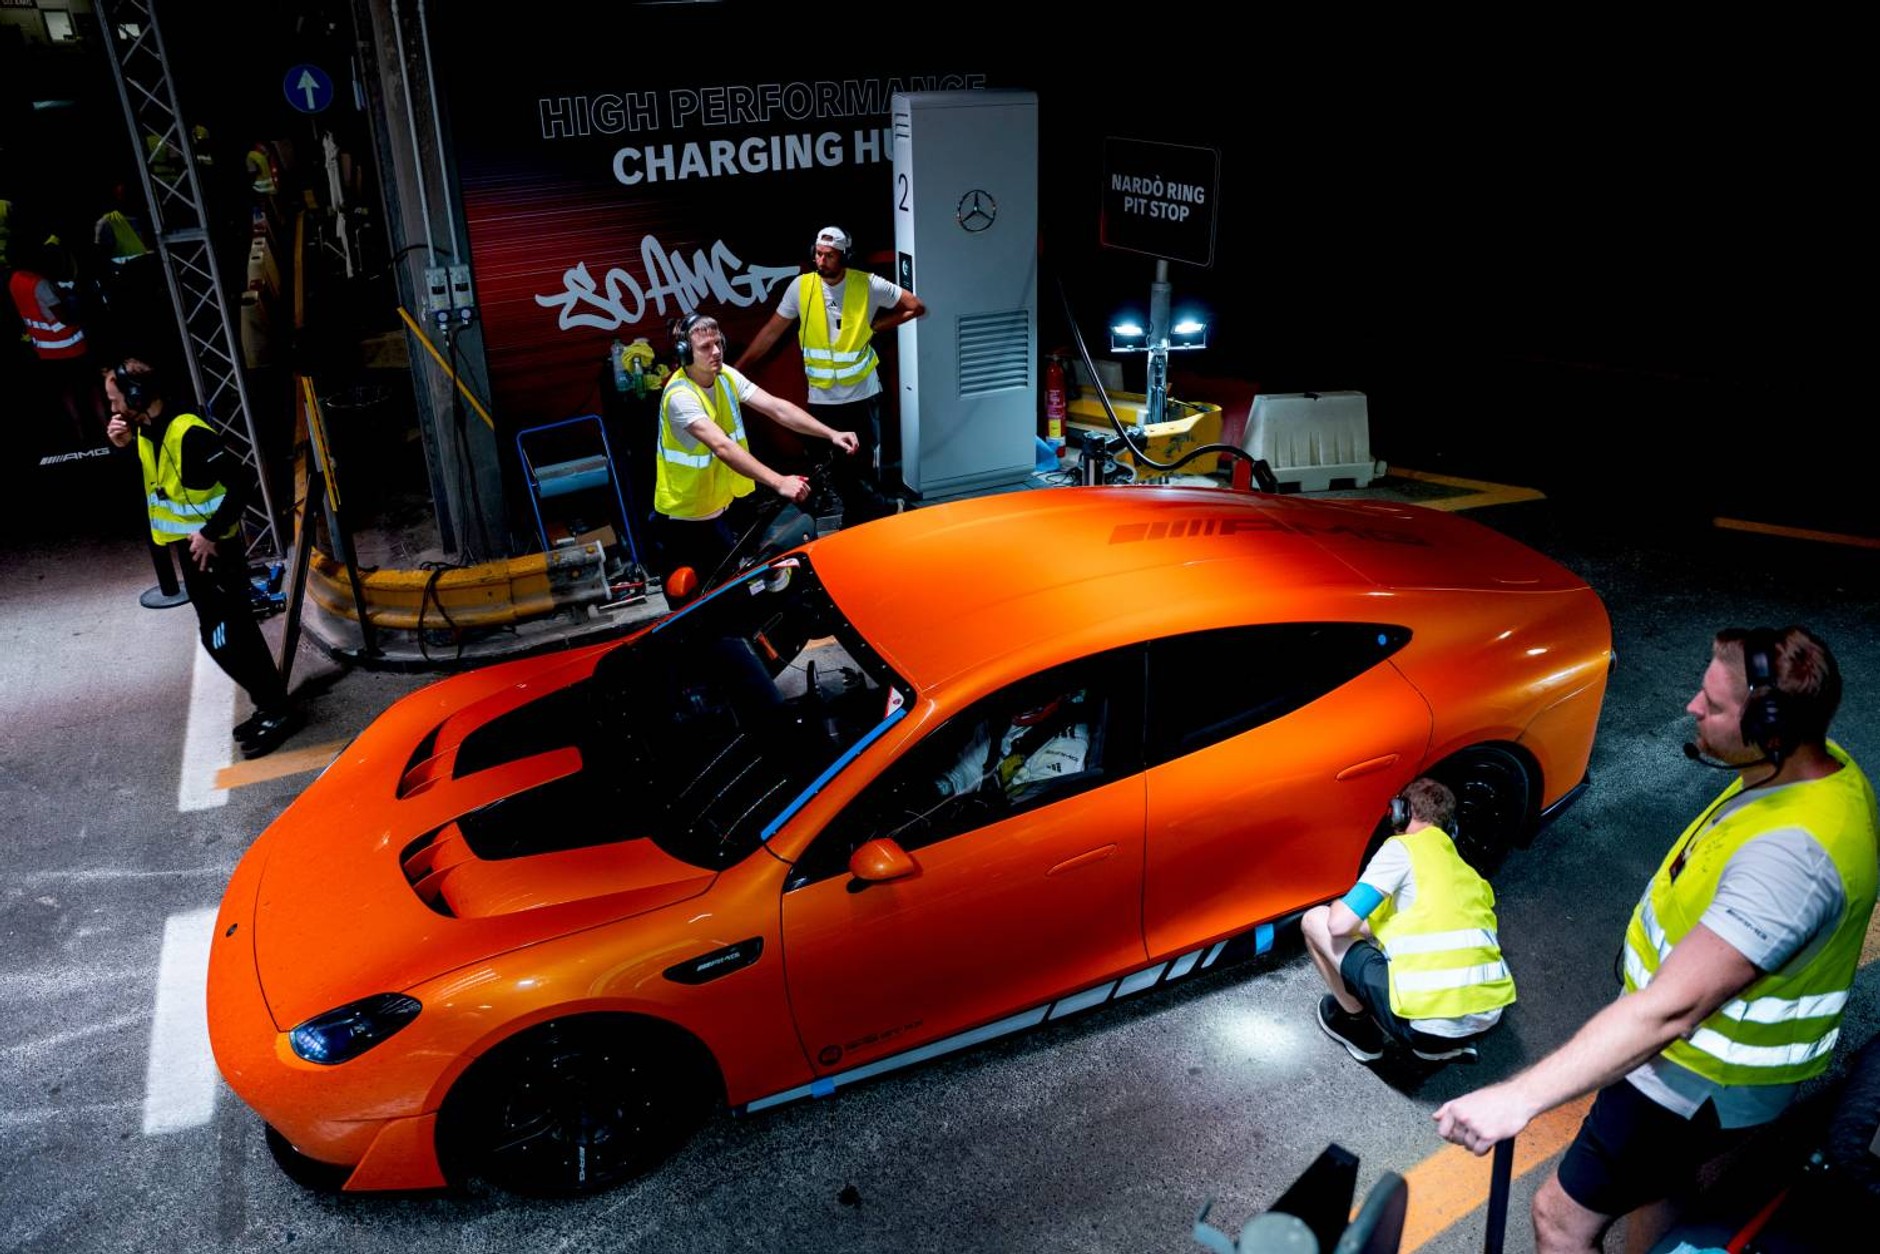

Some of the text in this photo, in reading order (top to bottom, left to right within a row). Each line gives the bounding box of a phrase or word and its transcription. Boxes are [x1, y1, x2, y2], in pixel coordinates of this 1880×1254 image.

[538, 91, 660, 140] HIGH
[612, 131, 844, 186] CHARGING
[898, 173, 909, 212] 2
[1111, 173, 1205, 204] NARDÒ RING
[1124, 196, 1191, 222] PIT STOP
